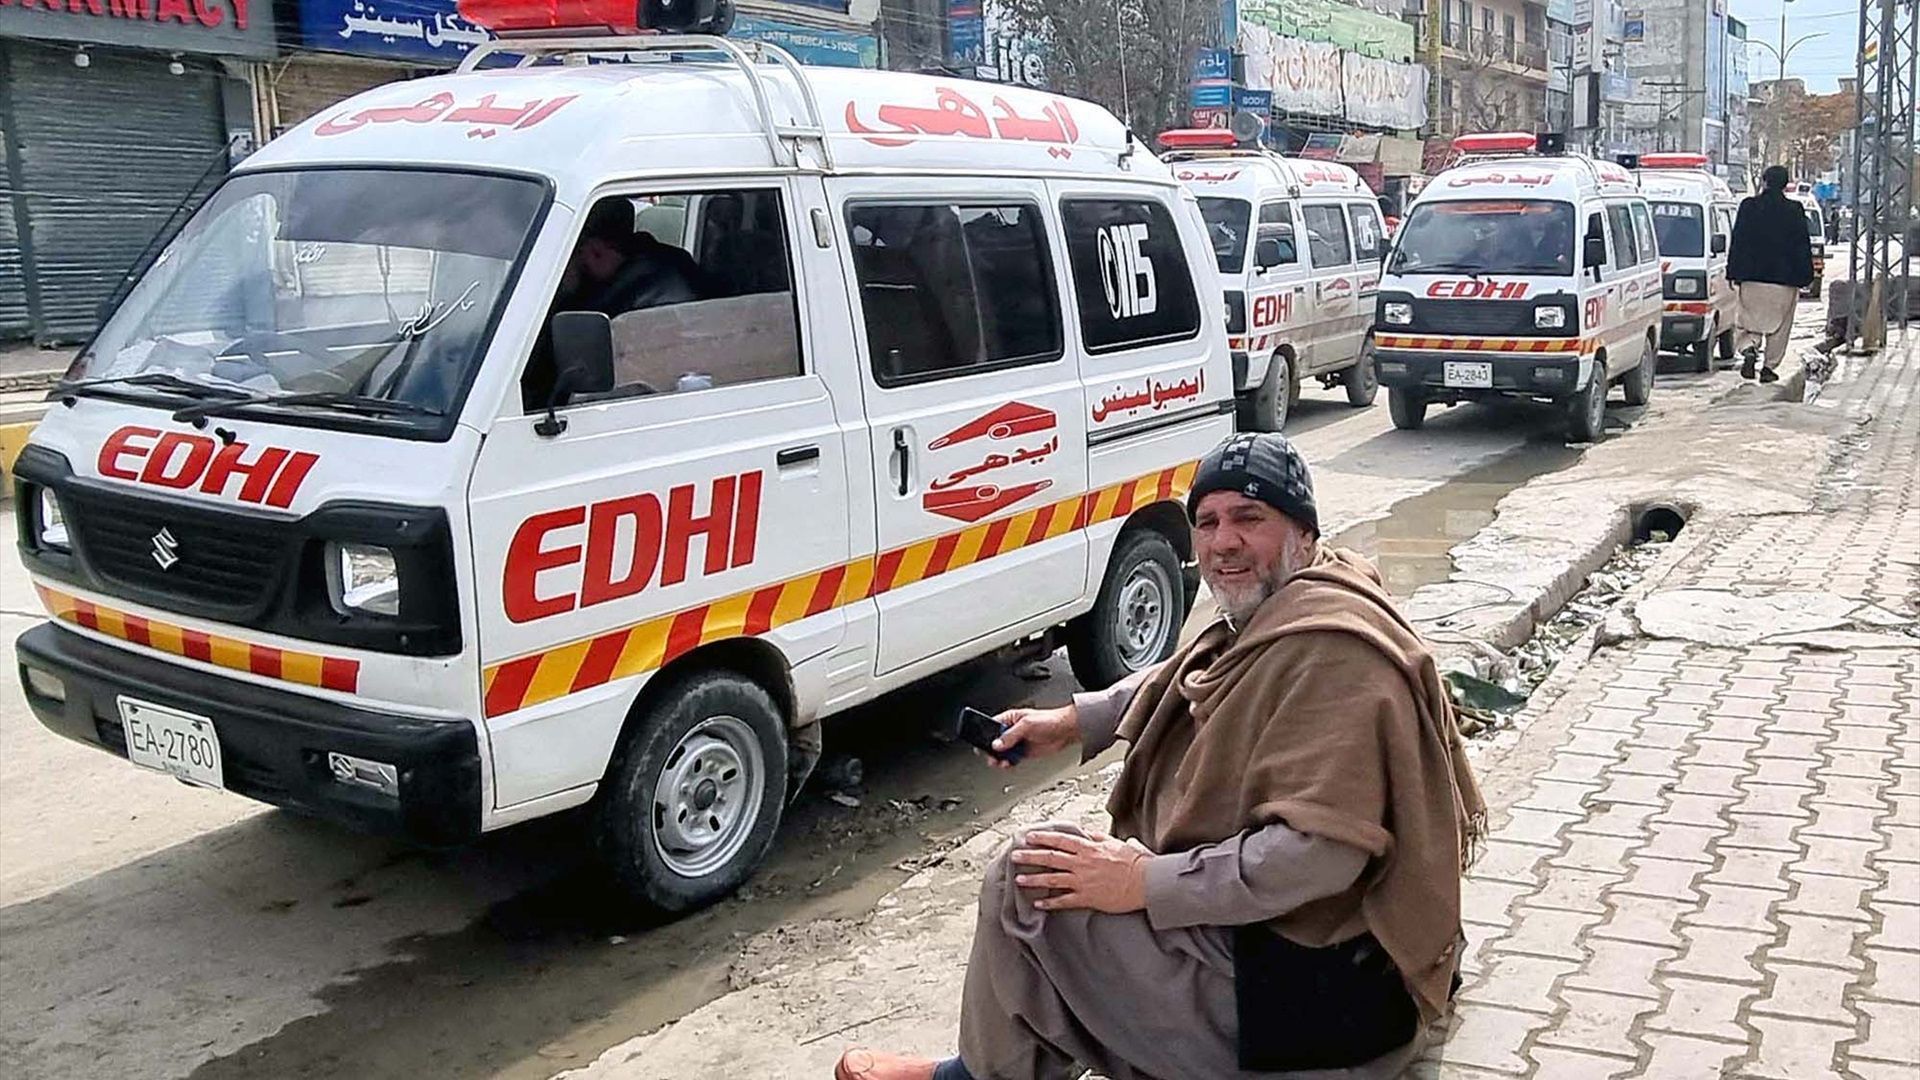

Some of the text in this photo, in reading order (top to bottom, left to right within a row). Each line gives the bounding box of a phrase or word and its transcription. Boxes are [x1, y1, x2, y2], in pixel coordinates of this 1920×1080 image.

[789, 34, 829, 48] MEDICAL
[314, 92, 580, 139] ایدھی
[845, 87, 1080, 161] ایدھی
[1253, 292, 1293, 328] EDHI
[1426, 281, 1530, 299] EDHI
[1448, 369, 1488, 381] EA-2843
[98, 425, 321, 510] EDHI
[930, 435, 1059, 490] ایدھی
[502, 469, 764, 624] EDHI
[130, 719, 215, 770] EA-2780
